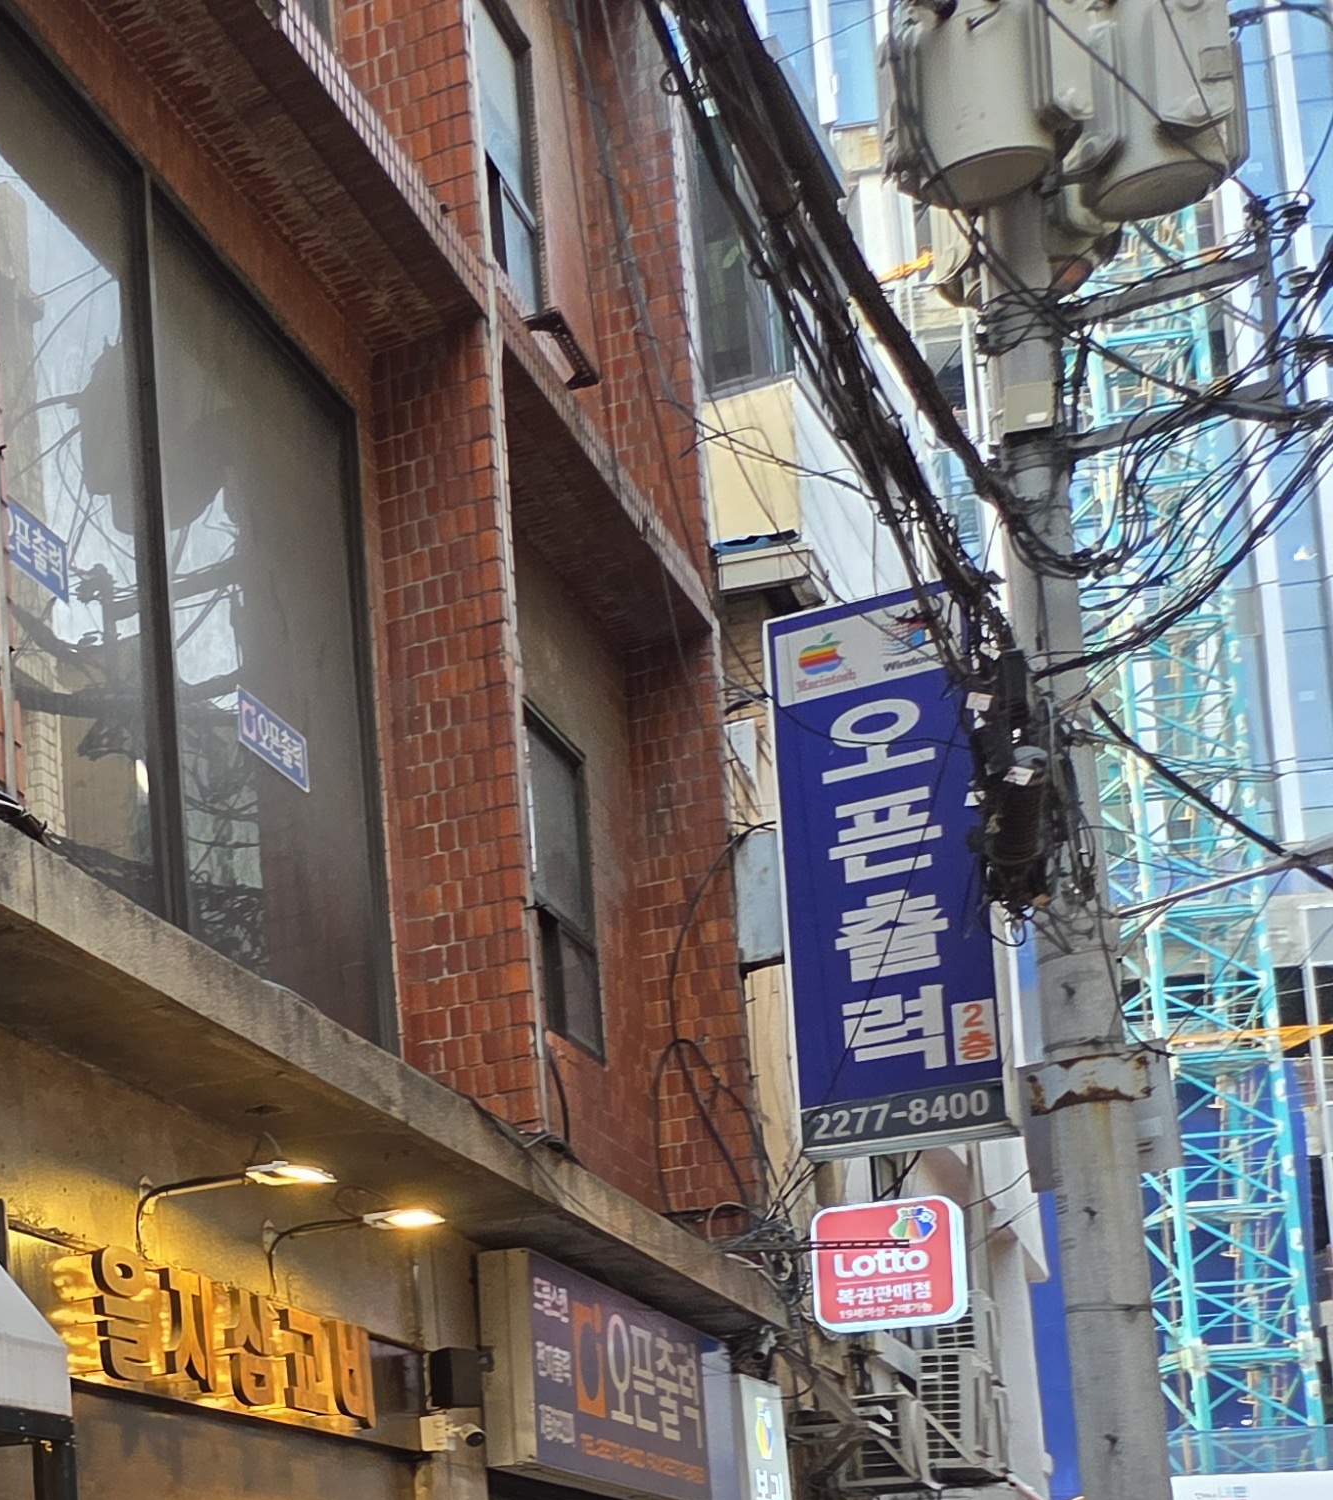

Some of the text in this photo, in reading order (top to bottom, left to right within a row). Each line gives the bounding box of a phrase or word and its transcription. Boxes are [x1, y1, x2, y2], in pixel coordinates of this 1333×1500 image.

[822, 698, 949, 1069] 오픈출력
[958, 1003, 994, 1061] 2층
[813, 1089, 990, 1141] 2277-8400
[833, 1247, 930, 1279] Lotto
[836, 1280, 932, 1306] 복권판매점
[607, 1314, 703, 1449] 오픈출력
